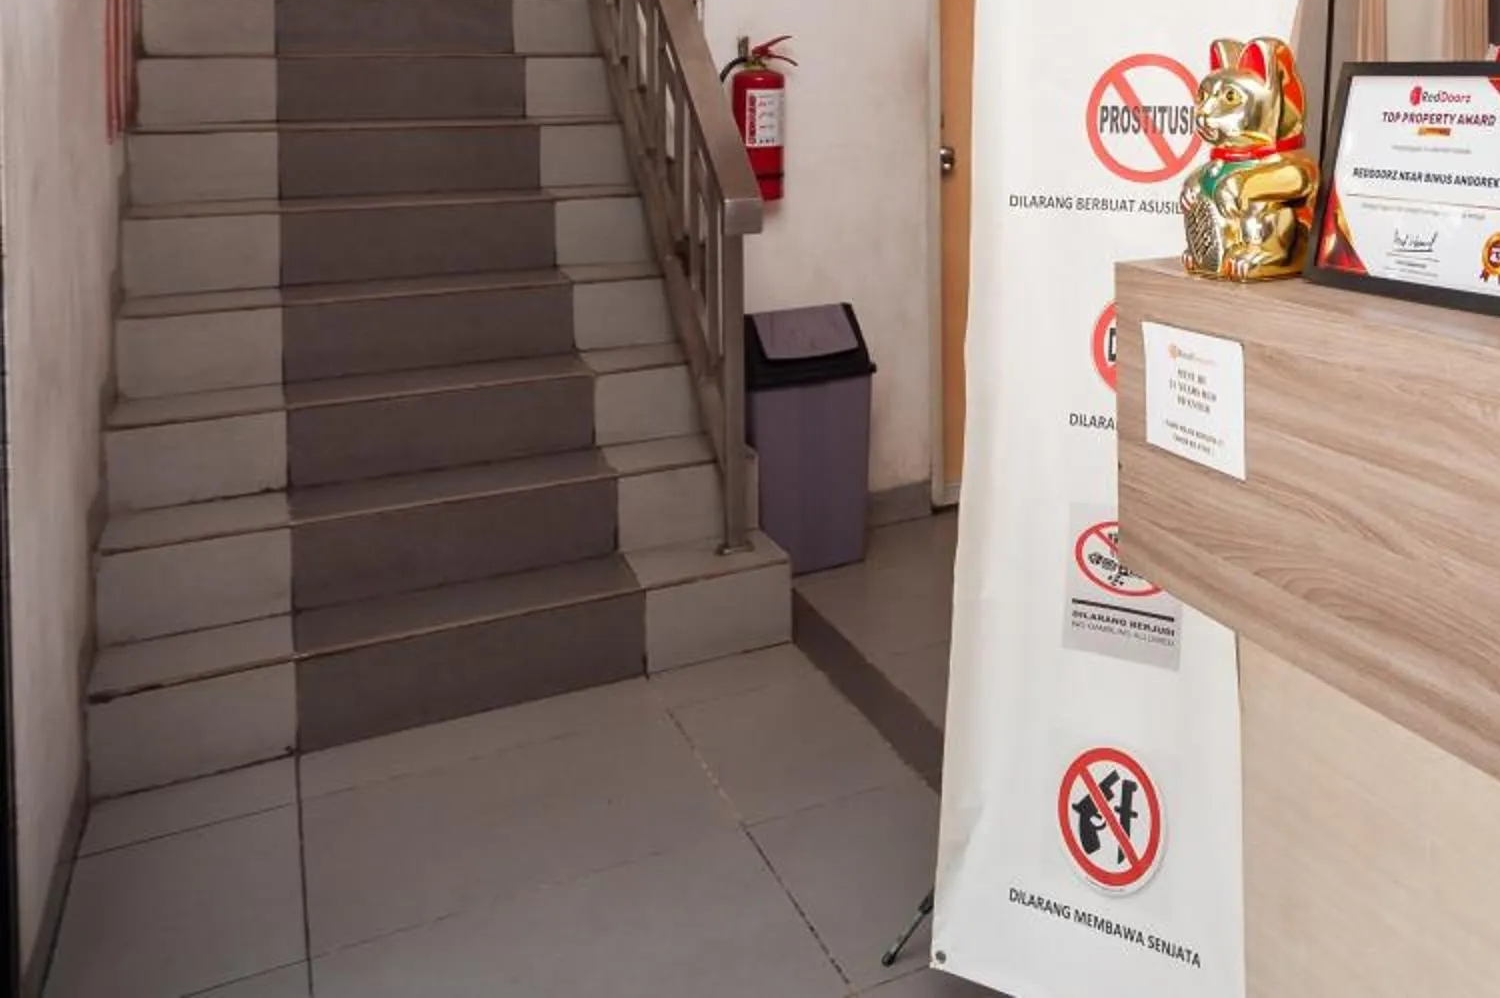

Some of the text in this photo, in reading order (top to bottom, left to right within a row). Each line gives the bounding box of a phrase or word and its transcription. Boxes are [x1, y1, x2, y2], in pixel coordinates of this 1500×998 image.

[1421, 90, 1472, 104] RedDoorz
[1099, 104, 1195, 136] PROSTITUSI
[1382, 111, 1497, 127] TOP PROPERTY AWARD
[1398, 170, 1423, 183] NEAR
[1009, 193, 1185, 216] DILARANG BERBUAT ASUSIL
[1068, 413, 1116, 431] DILARA
[1009, 887, 1202, 969] DILARANG MEMBAWA SENJATA
